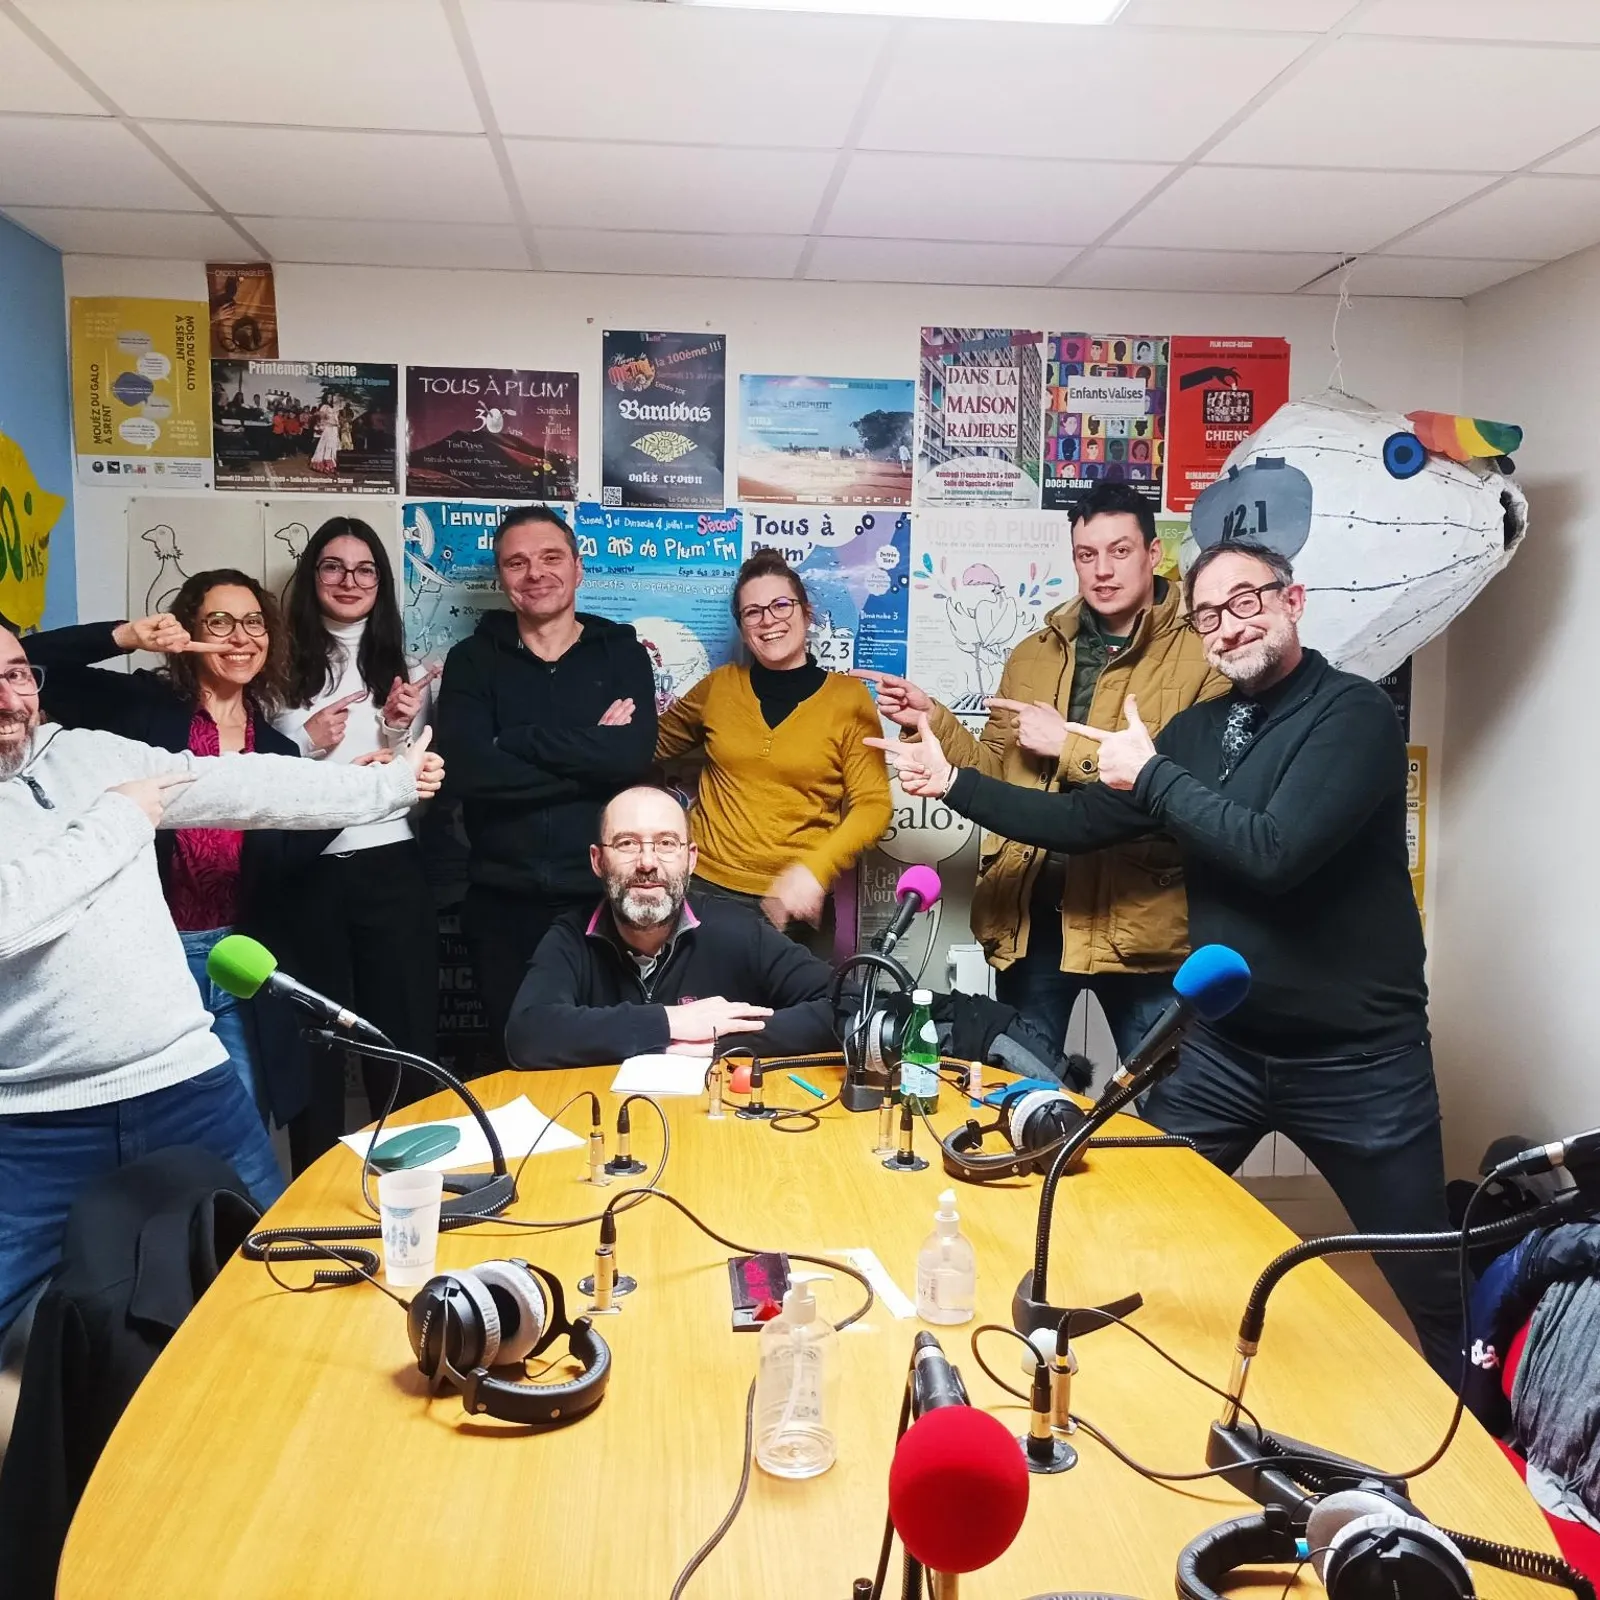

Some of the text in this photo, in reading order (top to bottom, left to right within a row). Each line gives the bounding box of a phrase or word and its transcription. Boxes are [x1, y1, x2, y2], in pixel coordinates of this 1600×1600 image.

[186, 316, 195, 390] MOIS DU GALLO
[667, 346, 708, 364] 100ème
[248, 361, 357, 377] Printemps Tsigane
[948, 368, 1017, 385] DANS LA
[419, 375, 568, 398] TOUS À PLUM'
[1069, 387, 1143, 399] Enfants Valises
[90, 364, 101, 444] MOUÉZ DU GALO
[536, 404, 571, 416] Samedi
[618, 399, 711, 422] Barabbas
[947, 396, 1016, 414] MAISON
[102, 404, 112, 434] SRENT
[541, 424, 572, 436] Juillet
[947, 423, 1016, 438] RADIEUSE
[1205, 430, 1249, 441] CHIENS
[1205, 441, 1240, 449] DE GAR
[628, 471, 703, 485] oaks crown
[1045, 479, 1093, 488] DOCU-DÉBAT
[442, 504, 507, 526] l'envol
[579, 515, 604, 525] Samedi
[605, 514, 612, 529] 3
[624, 519, 655, 529] Dimanche
[655, 517, 663, 530] 4
[664, 520, 682, 531] juillet
[754, 513, 835, 536] Tous à
[926, 519, 976, 540] TOUS
[577, 534, 597, 557] 20
[607, 536, 634, 557] ans
[639, 539, 657, 558] de
[751, 540, 812, 562] Pum'
[490, 582, 497, 592] 4
[631, 581, 642, 592] et
[860, 609, 891, 620] Dimanche
[839, 642, 849, 659] 3
[970, 727, 984, 735] 201
[864, 884, 897, 907] Nouv
